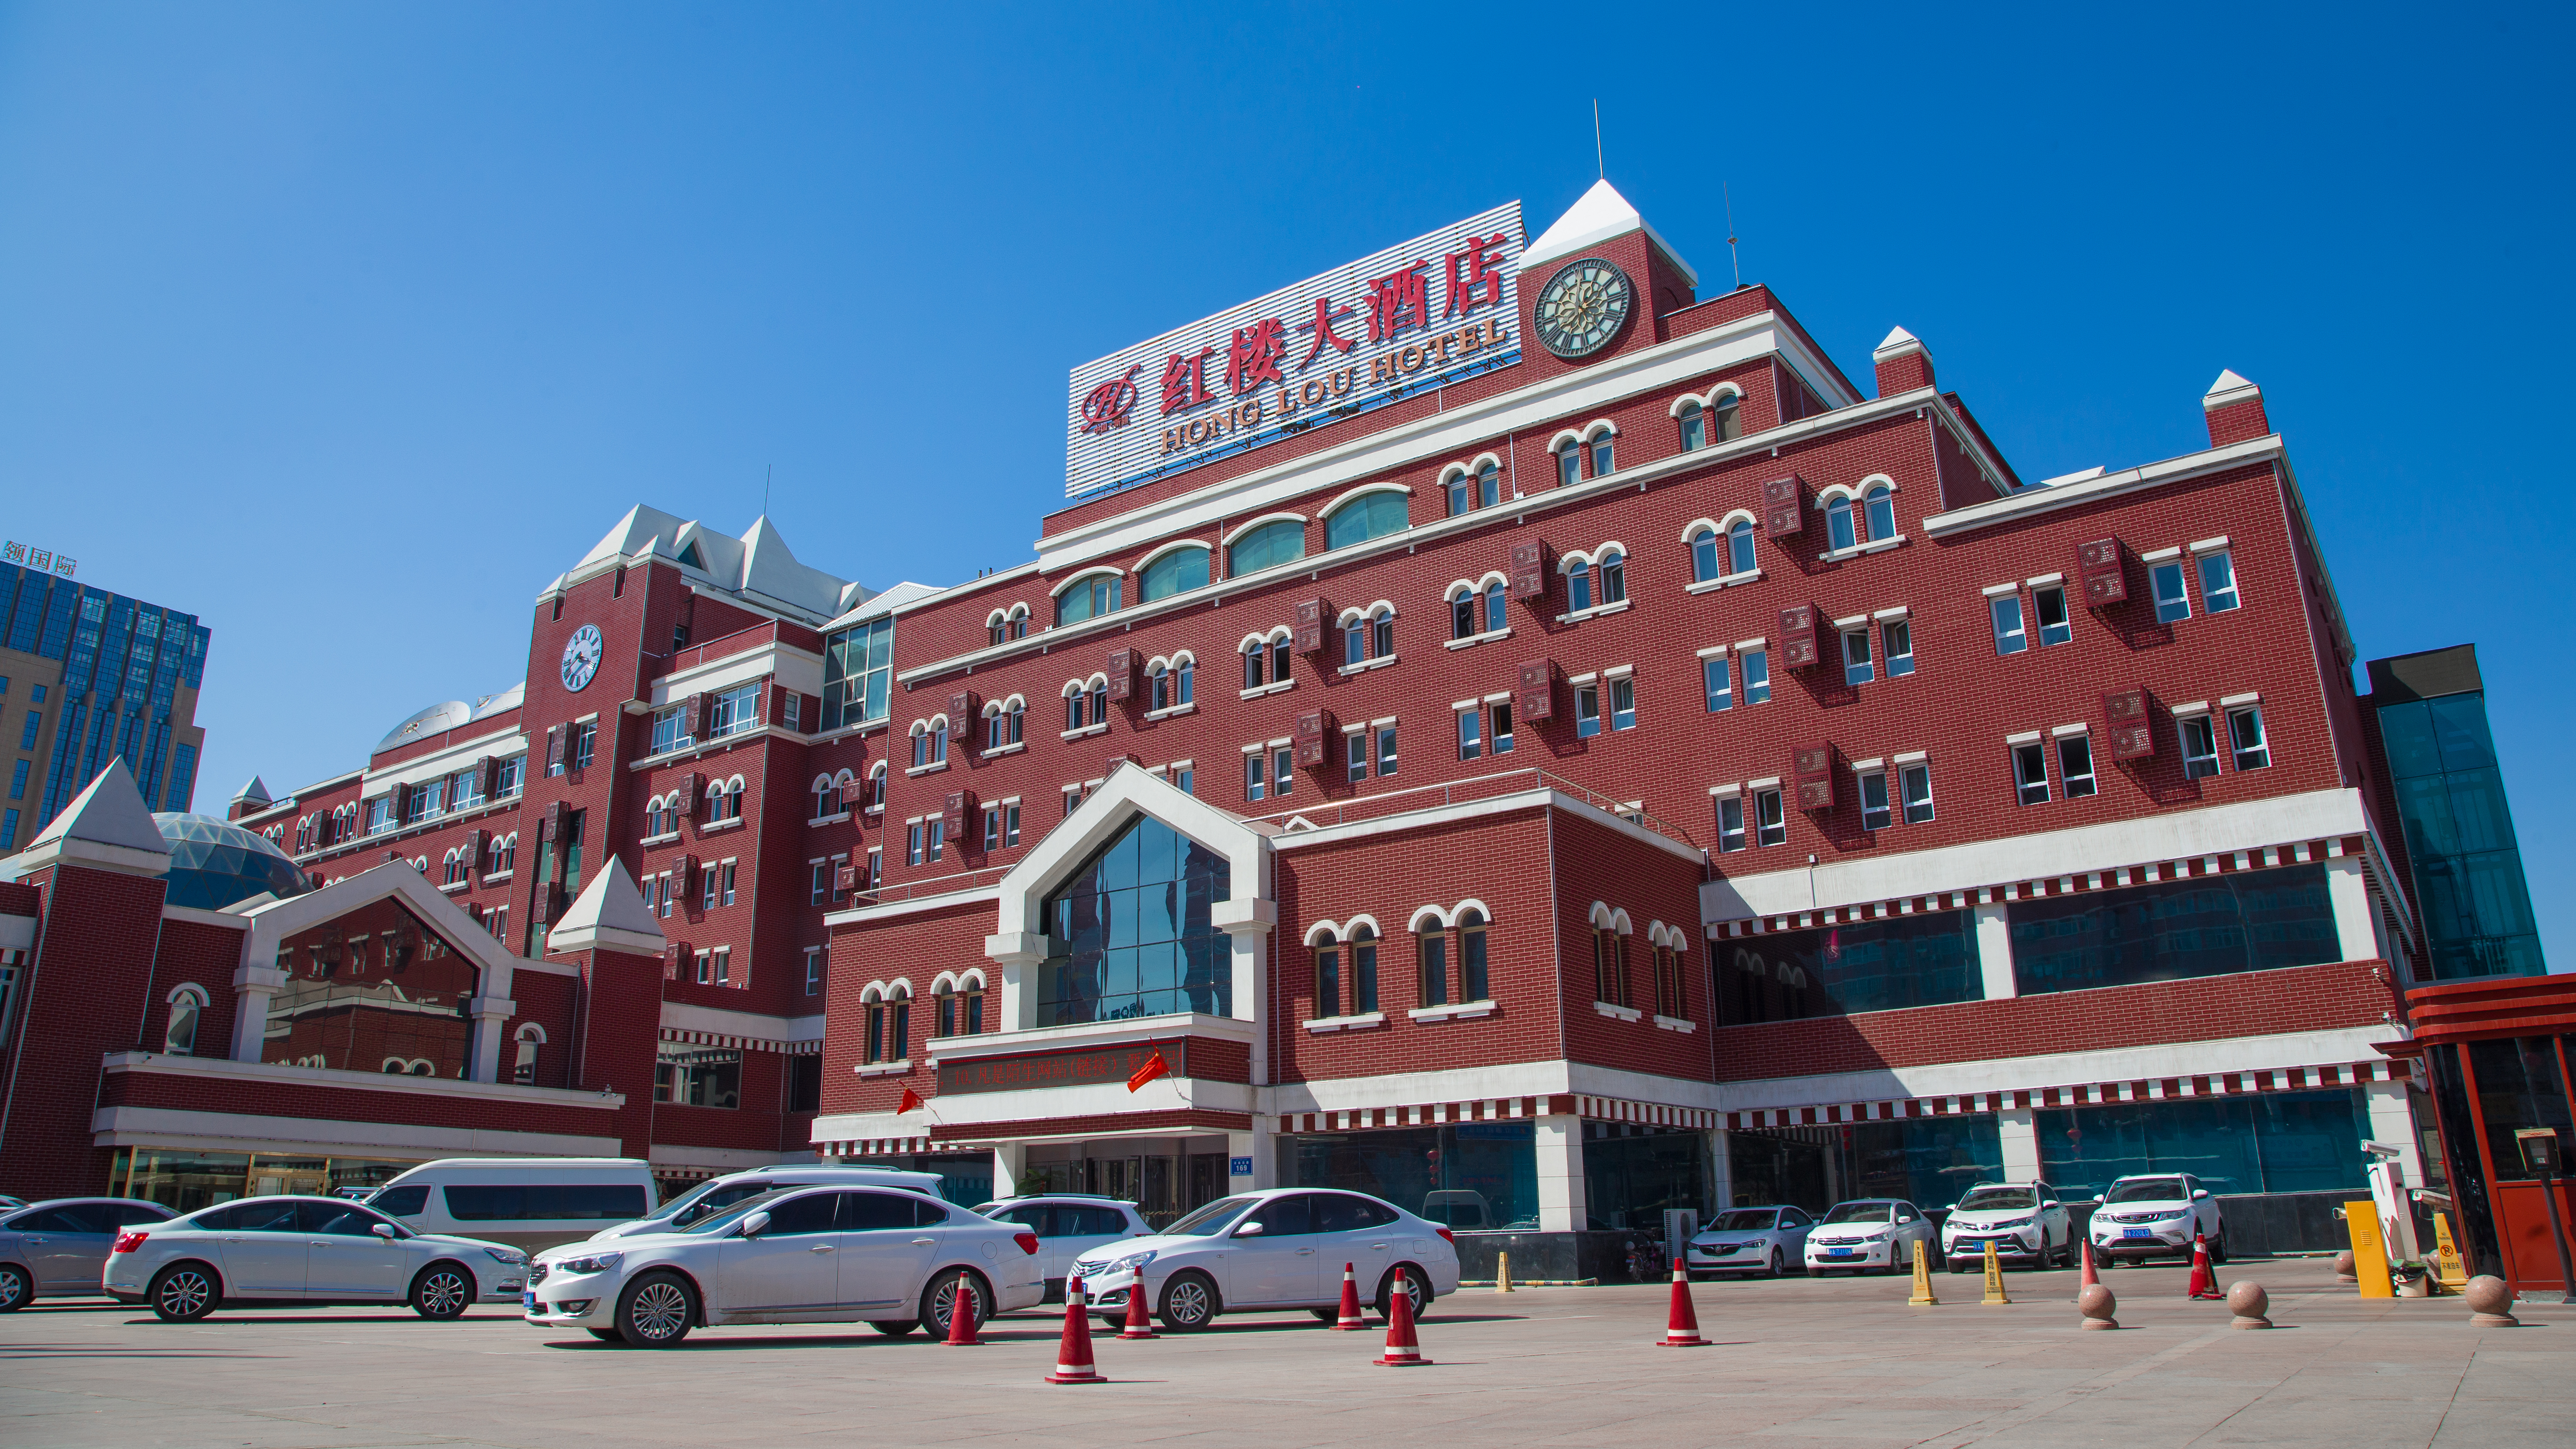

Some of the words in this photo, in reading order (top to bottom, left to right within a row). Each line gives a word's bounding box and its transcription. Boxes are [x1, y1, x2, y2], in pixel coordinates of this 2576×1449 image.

[1159, 233, 1506, 415] 红楼大酒店
[1159, 399, 1261, 455] HONG
[1276, 367, 1353, 416] LOU
[1368, 318, 1506, 385] HOTEL
[4, 540, 77, 575] 领国际
